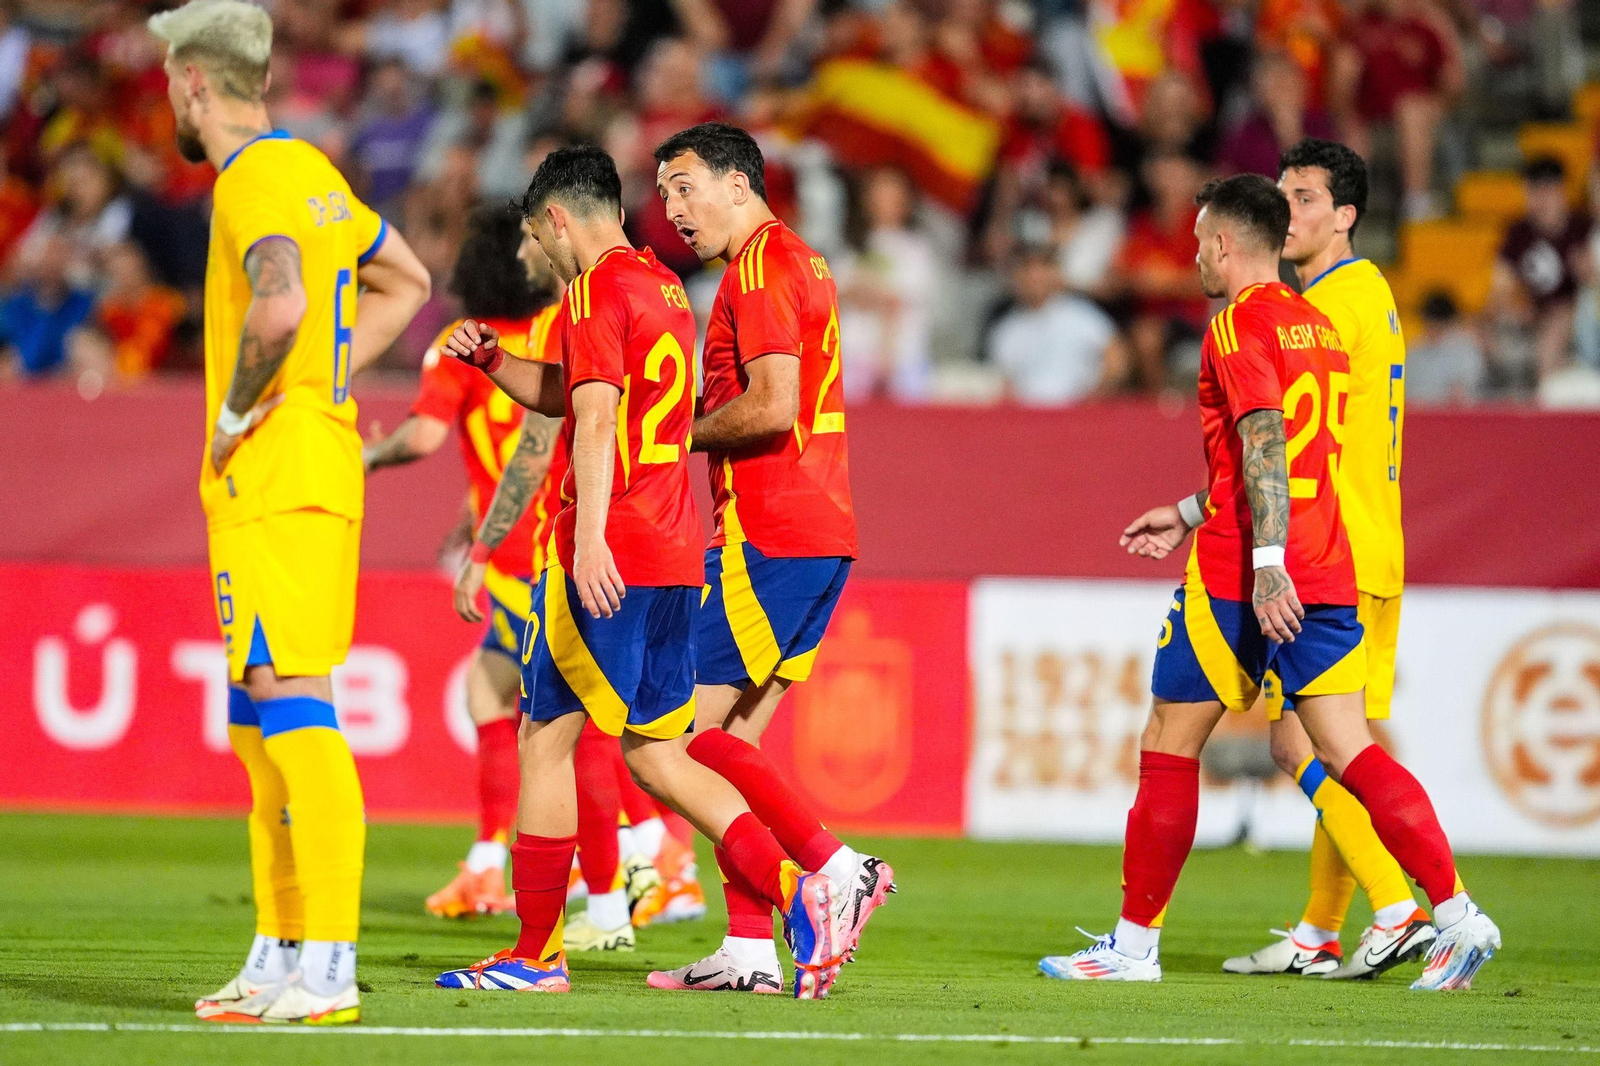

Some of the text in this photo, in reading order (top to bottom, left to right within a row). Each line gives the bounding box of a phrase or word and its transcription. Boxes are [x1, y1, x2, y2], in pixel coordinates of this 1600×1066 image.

[334, 269, 353, 404] 6
[1276, 324, 1317, 350] ALEIX
[1282, 370, 1351, 499] 25
[1388, 364, 1404, 481] 5
[217, 571, 234, 626] 6
